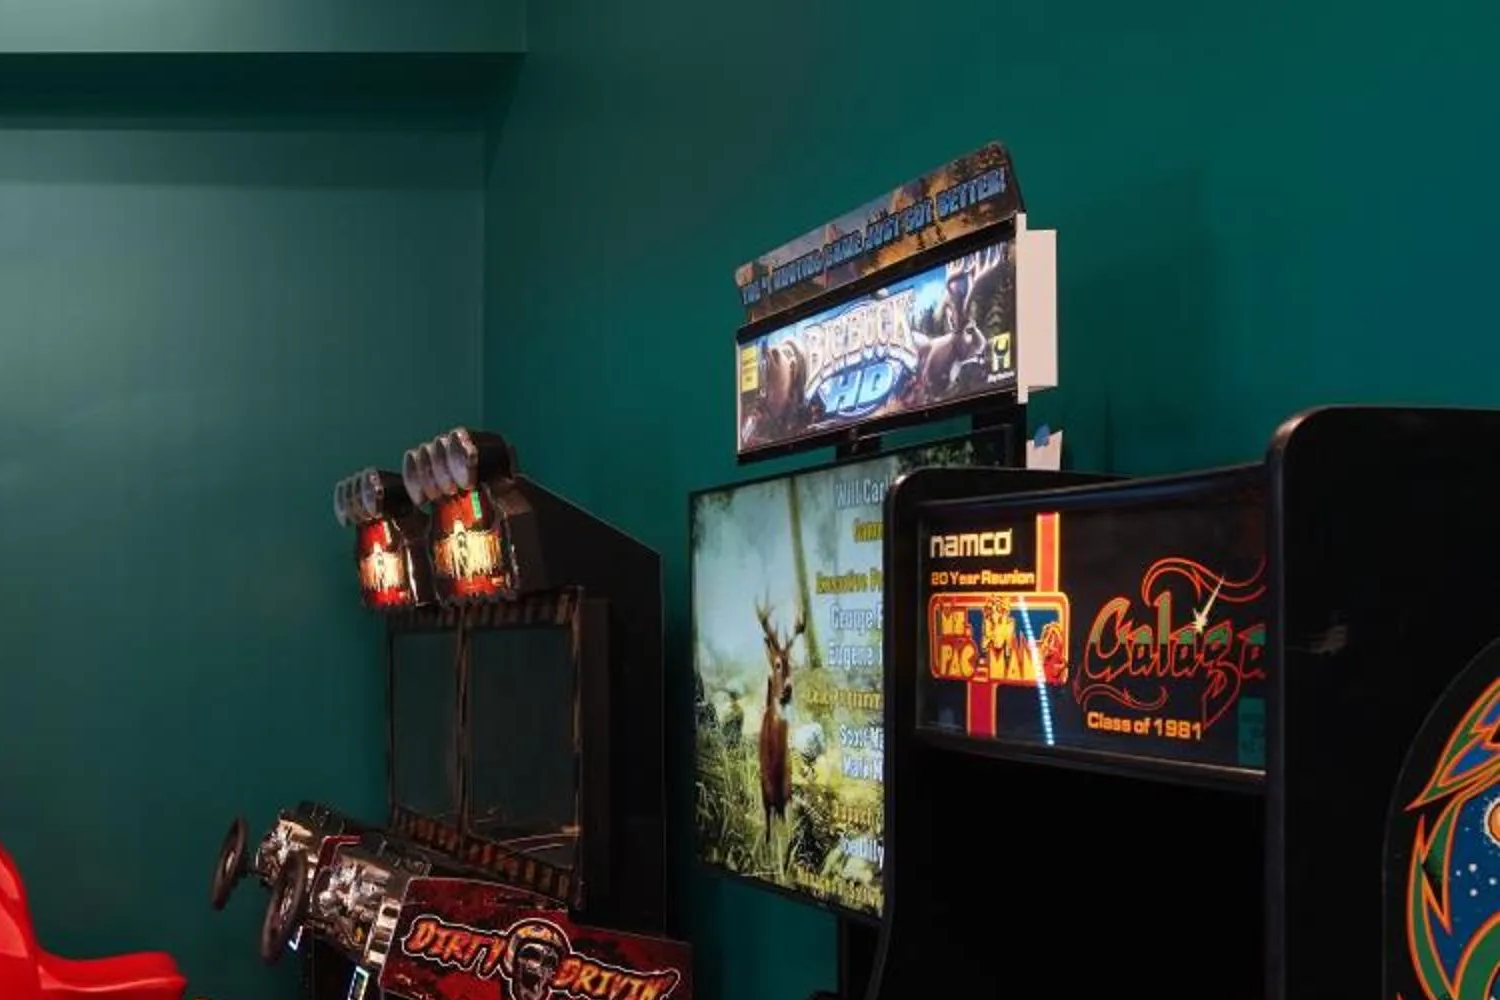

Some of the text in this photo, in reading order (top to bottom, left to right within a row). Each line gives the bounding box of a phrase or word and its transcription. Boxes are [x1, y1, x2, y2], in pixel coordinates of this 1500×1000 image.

[802, 319, 845, 392] BIG
[846, 293, 917, 356] BUCK
[825, 360, 894, 413] HD
[930, 528, 1013, 559] namco
[931, 568, 1035, 586] 20 Year Reunion
[1087, 711, 1202, 741] Class of 1981
[405, 918, 504, 974] DIRTY
